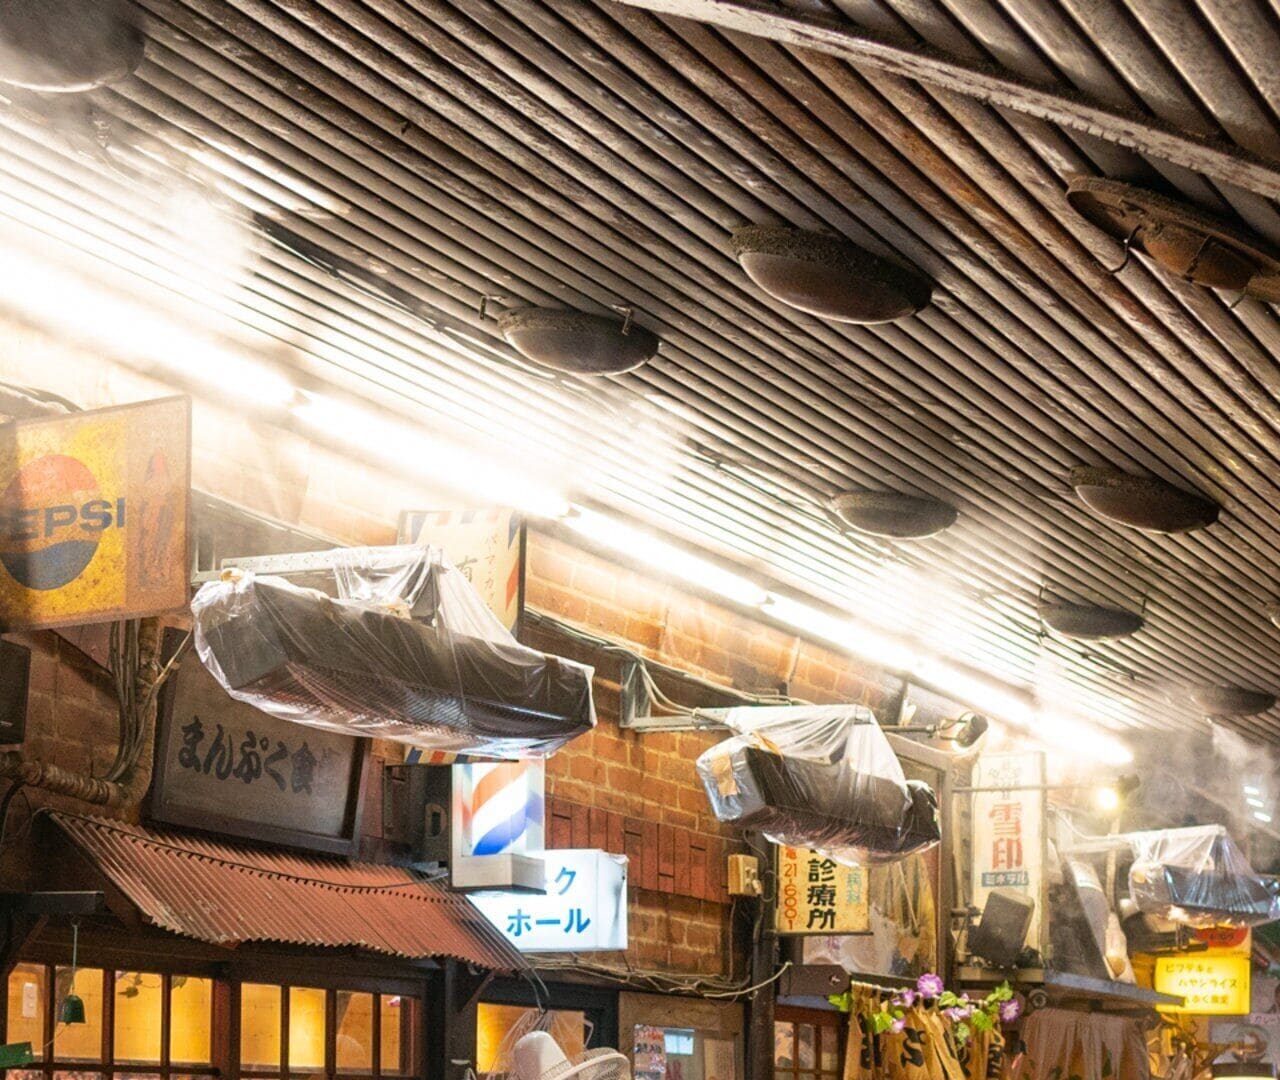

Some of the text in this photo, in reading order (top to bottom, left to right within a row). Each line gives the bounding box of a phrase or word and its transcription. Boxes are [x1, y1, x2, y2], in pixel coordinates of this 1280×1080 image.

[178, 714, 342, 795] まんぷく食
[506, 908, 592, 937] ホール
[806, 849, 837, 930] 診療所
